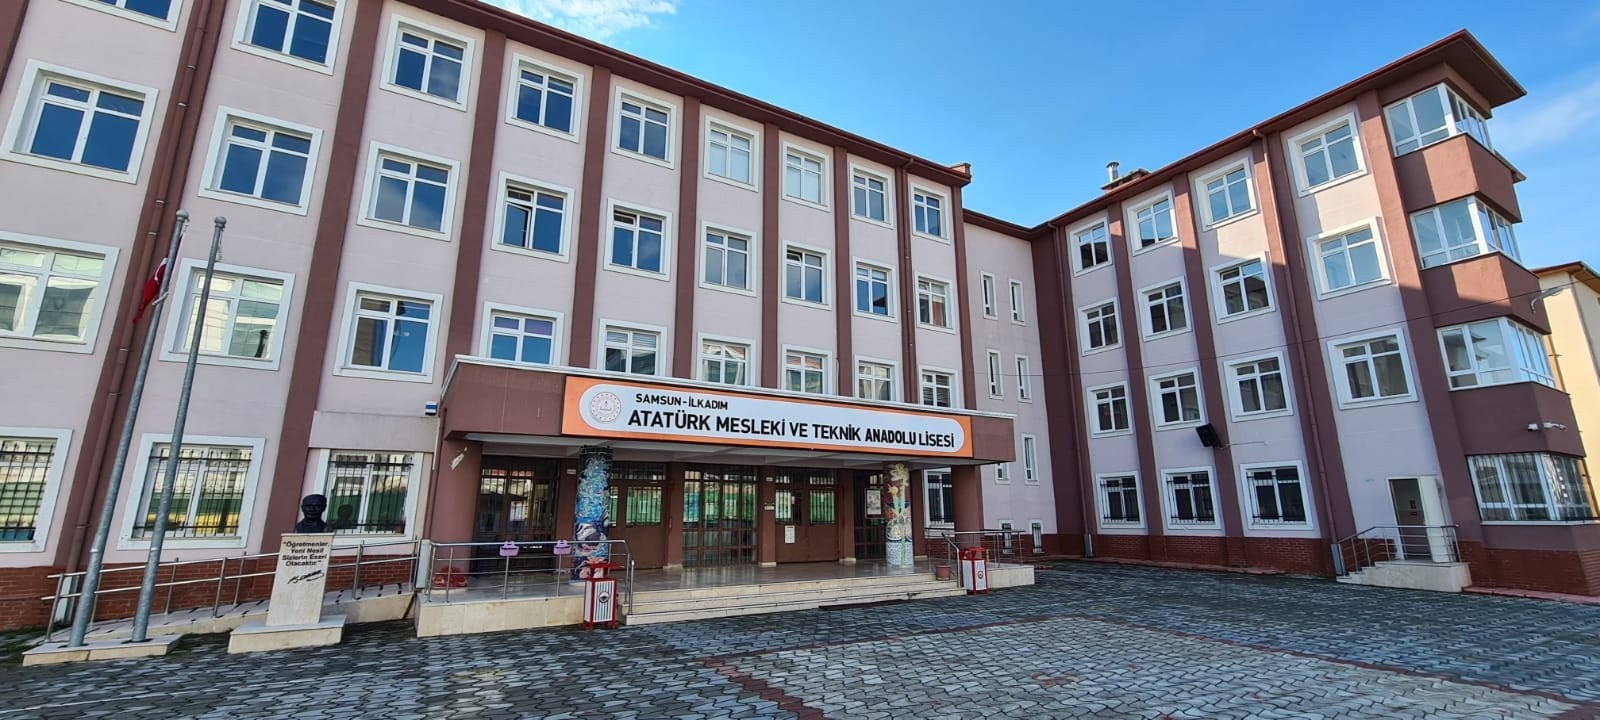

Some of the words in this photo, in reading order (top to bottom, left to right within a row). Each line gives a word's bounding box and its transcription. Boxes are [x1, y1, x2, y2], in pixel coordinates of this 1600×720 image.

[628, 409, 711, 431] ATATÜRK
[716, 416, 785, 436] MESLEKİ
[789, 421, 808, 437] VE
[812, 423, 862, 441] TEKNİK
[865, 428, 917, 446] ANADOLU
[919, 431, 954, 448] LİSESİ
